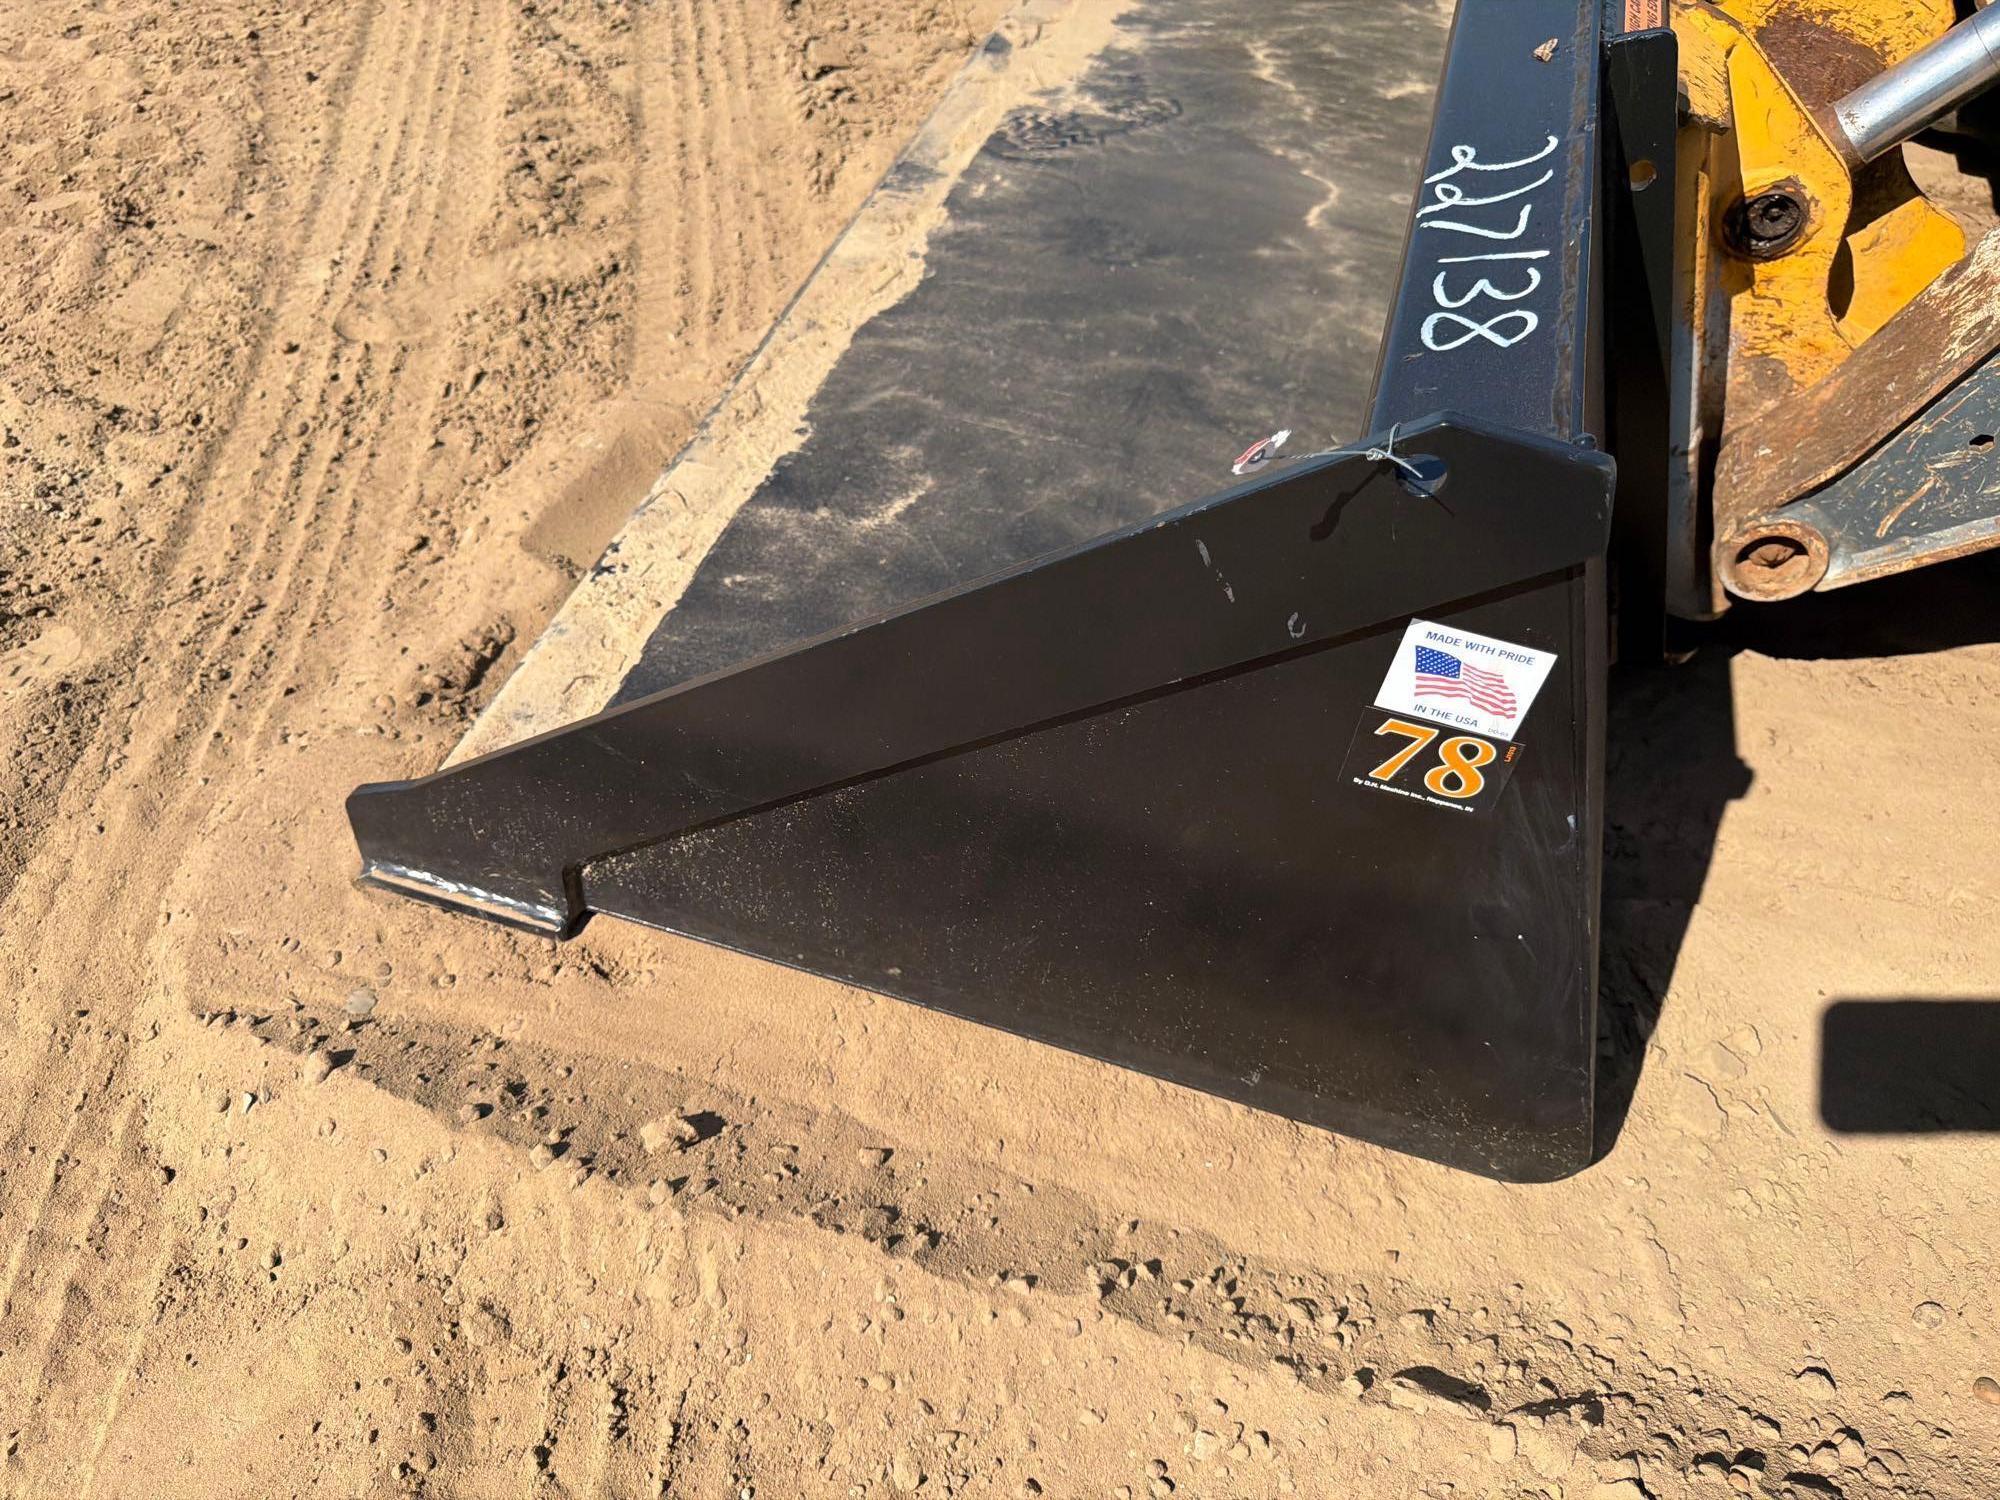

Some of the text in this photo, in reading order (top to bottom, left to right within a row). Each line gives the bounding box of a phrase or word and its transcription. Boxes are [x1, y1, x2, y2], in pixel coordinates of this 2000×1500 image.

[1416, 136, 1558, 351] 227138
[1424, 630, 1536, 666] MADE WITH PRIDE
[1413, 704, 1478, 728] IN THE USA
[1368, 718, 1497, 798] 78
[1353, 777, 1363, 785] By
